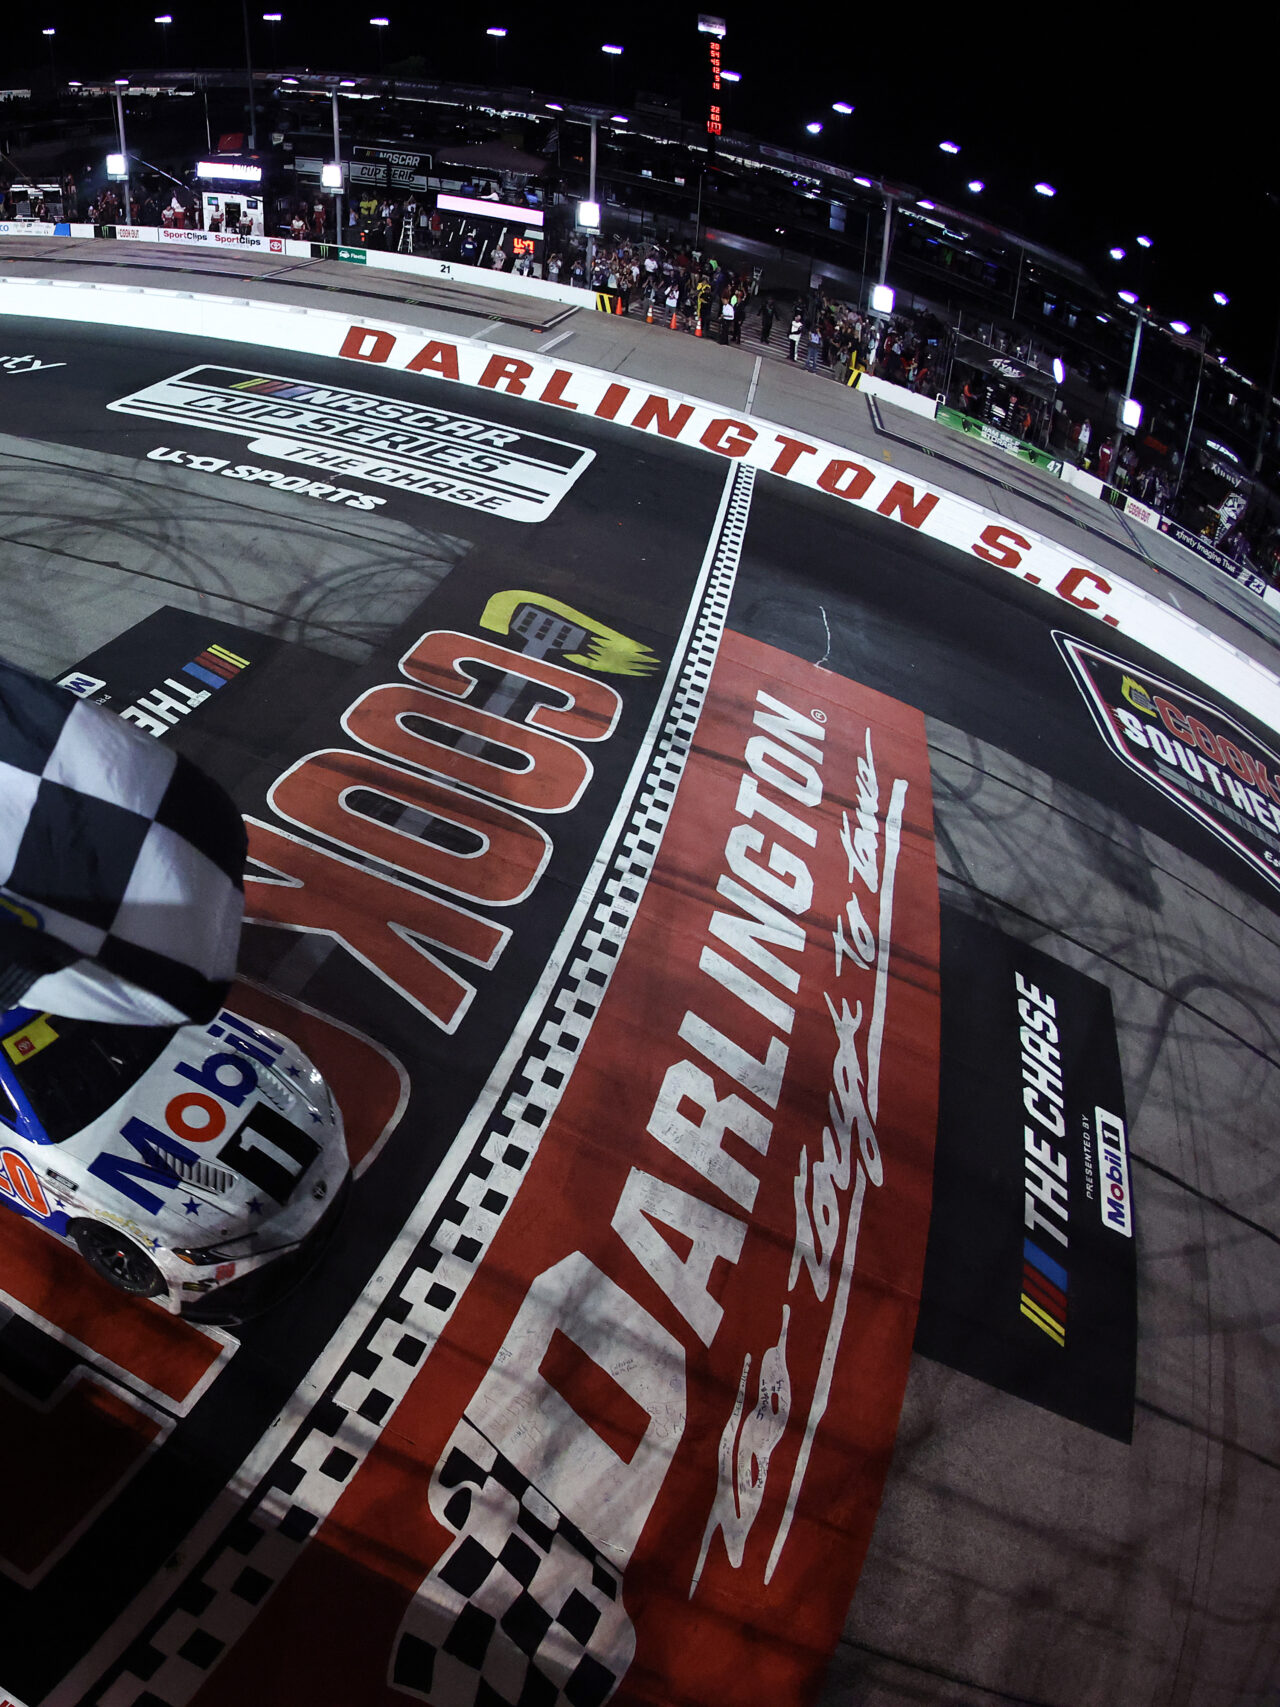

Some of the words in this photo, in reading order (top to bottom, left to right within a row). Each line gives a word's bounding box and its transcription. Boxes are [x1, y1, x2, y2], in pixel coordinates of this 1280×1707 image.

[710, 42, 720, 50] 20
[710, 50, 720, 58] 54
[712, 66, 720, 74] 12
[715, 74, 720, 82] 5
[710, 105, 720, 114] 22
[361, 167, 381, 177] CUP
[440, 264, 451, 274] 21
[184, 394, 302, 421] CUP
[297, 417, 512, 474] SERIES
[298, 386, 520, 448] NASCAR
[223, 465, 388, 511] SPORTS
[285, 446, 360, 470] THE
[363, 465, 513, 511] CHASE
[338, 325, 940, 530] DARLINGTON
[970, 524, 1121, 627] S.C.
[1046, 460, 1061, 474] 47
[1197, 541, 1222, 564] Imagine
[1249, 578, 1266, 594] 23
[118, 678, 212, 738] THE
[1153, 696, 1277, 801] COOK
[241, 630, 623, 1035] COOK
[1014, 971, 1067, 1139] CHASE
[87, 1011, 285, 1216] Mobil
[463, 690, 826, 1574] DARLINGTON
[1081, 1113, 1090, 1130] BY
[1024, 1125, 1069, 1248] THE
[1083, 1131, 1094, 1200] PRESENTED
[1104, 1148, 1125, 1228] Mobil
